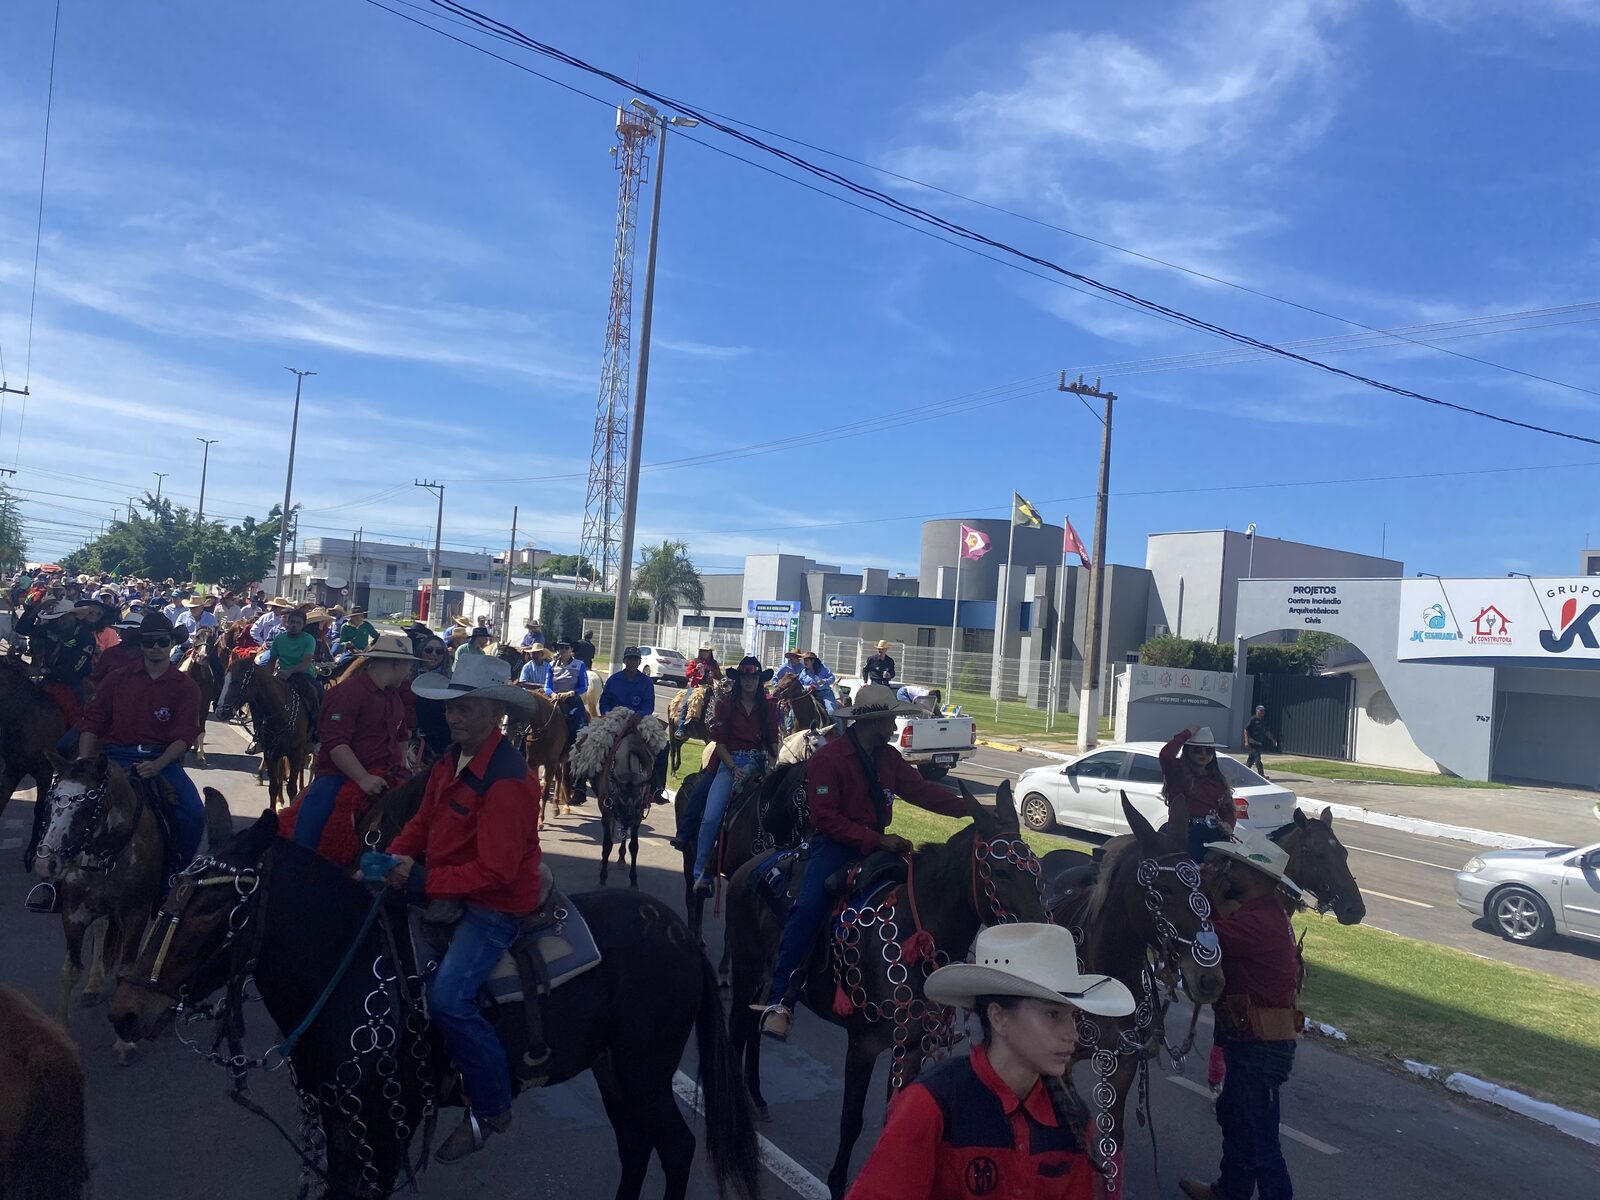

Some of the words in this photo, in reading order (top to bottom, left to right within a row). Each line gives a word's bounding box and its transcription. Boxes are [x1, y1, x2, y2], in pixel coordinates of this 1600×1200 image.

[1293, 586, 1337, 595] PROJETOS
[1547, 585, 1600, 598] GRUPO
[1312, 597, 1341, 605] Incêndio
[1289, 607, 1339, 615] Arquitetônicos
[1539, 598, 1600, 653] JK
[1410, 631, 1424, 642] JK
